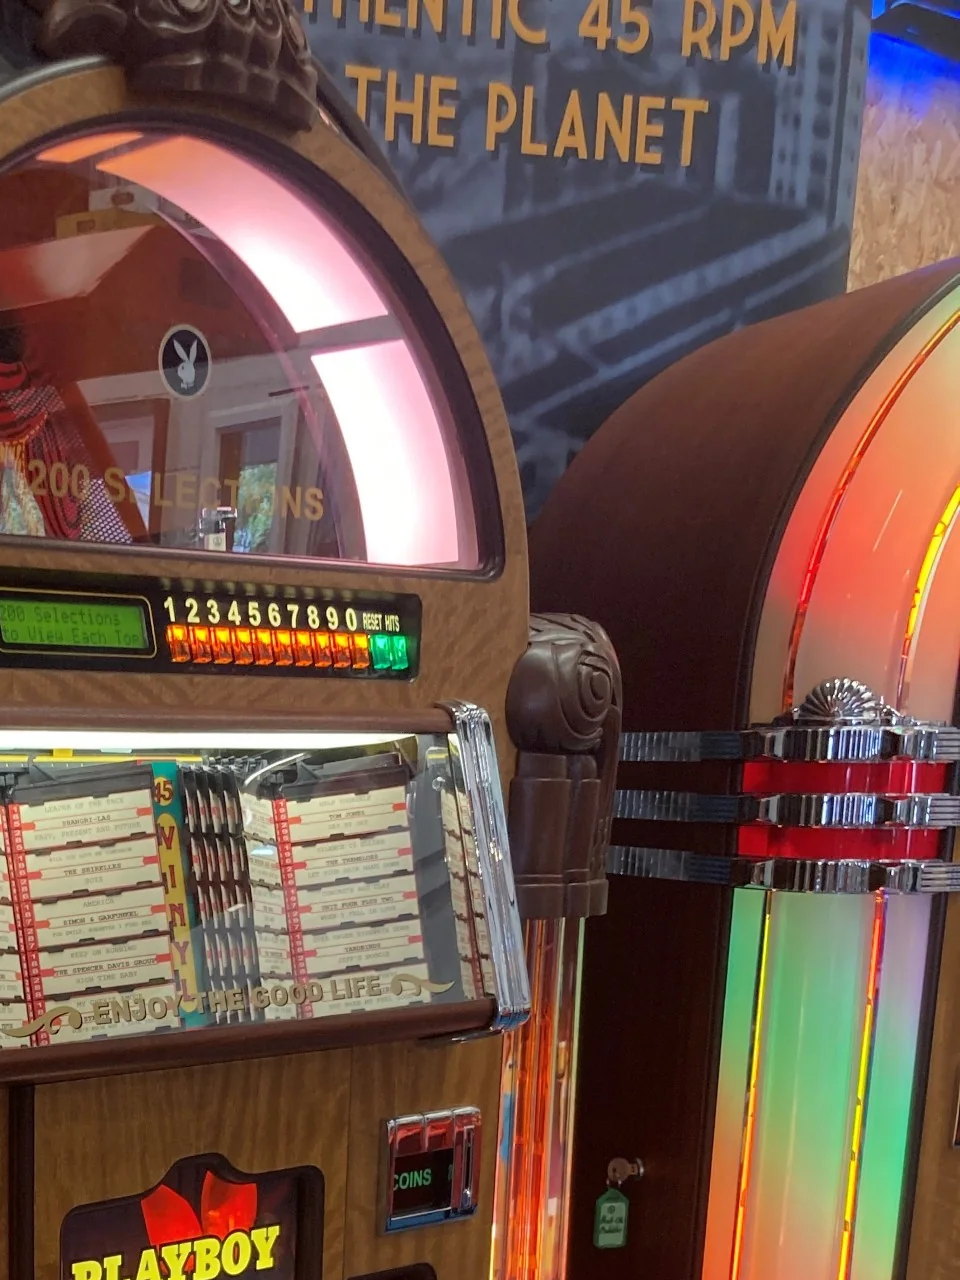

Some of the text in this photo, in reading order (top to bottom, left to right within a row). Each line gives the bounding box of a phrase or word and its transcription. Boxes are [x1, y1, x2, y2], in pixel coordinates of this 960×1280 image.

[578, 0, 650, 54] 45
[681, 0, 797, 67] RPM
[344, 63, 709, 167] THE PLANET
[28, 459, 90, 500] 200
[0, 605, 121, 626] 200 Selections
[164, 596, 358, 631] 1 2 3 4 5 6 7 8 9 0
[362, 613, 400, 632] RESET HITS
[3, 629, 19, 641] to
[28, 627, 64, 642] View
[72, 628, 107, 645] Each
[154, 781, 173, 804] 45
[62, 814, 111, 827] SHANGRI-LAS
[63, 916, 86, 926] SIMON
[159, 826, 196, 1002] VINYL
[72, 964, 104, 975] SPENCER
[107, 960, 131, 971] DAVIS
[133, 957, 158, 967] GROUP
[93, 994, 183, 1025] ENJOY
[193, 988, 244, 1014] THE
[251, 981, 324, 1010] GOOD
[331, 975, 385, 1001] LIFE
[393, 1168, 432, 1191] COINS
